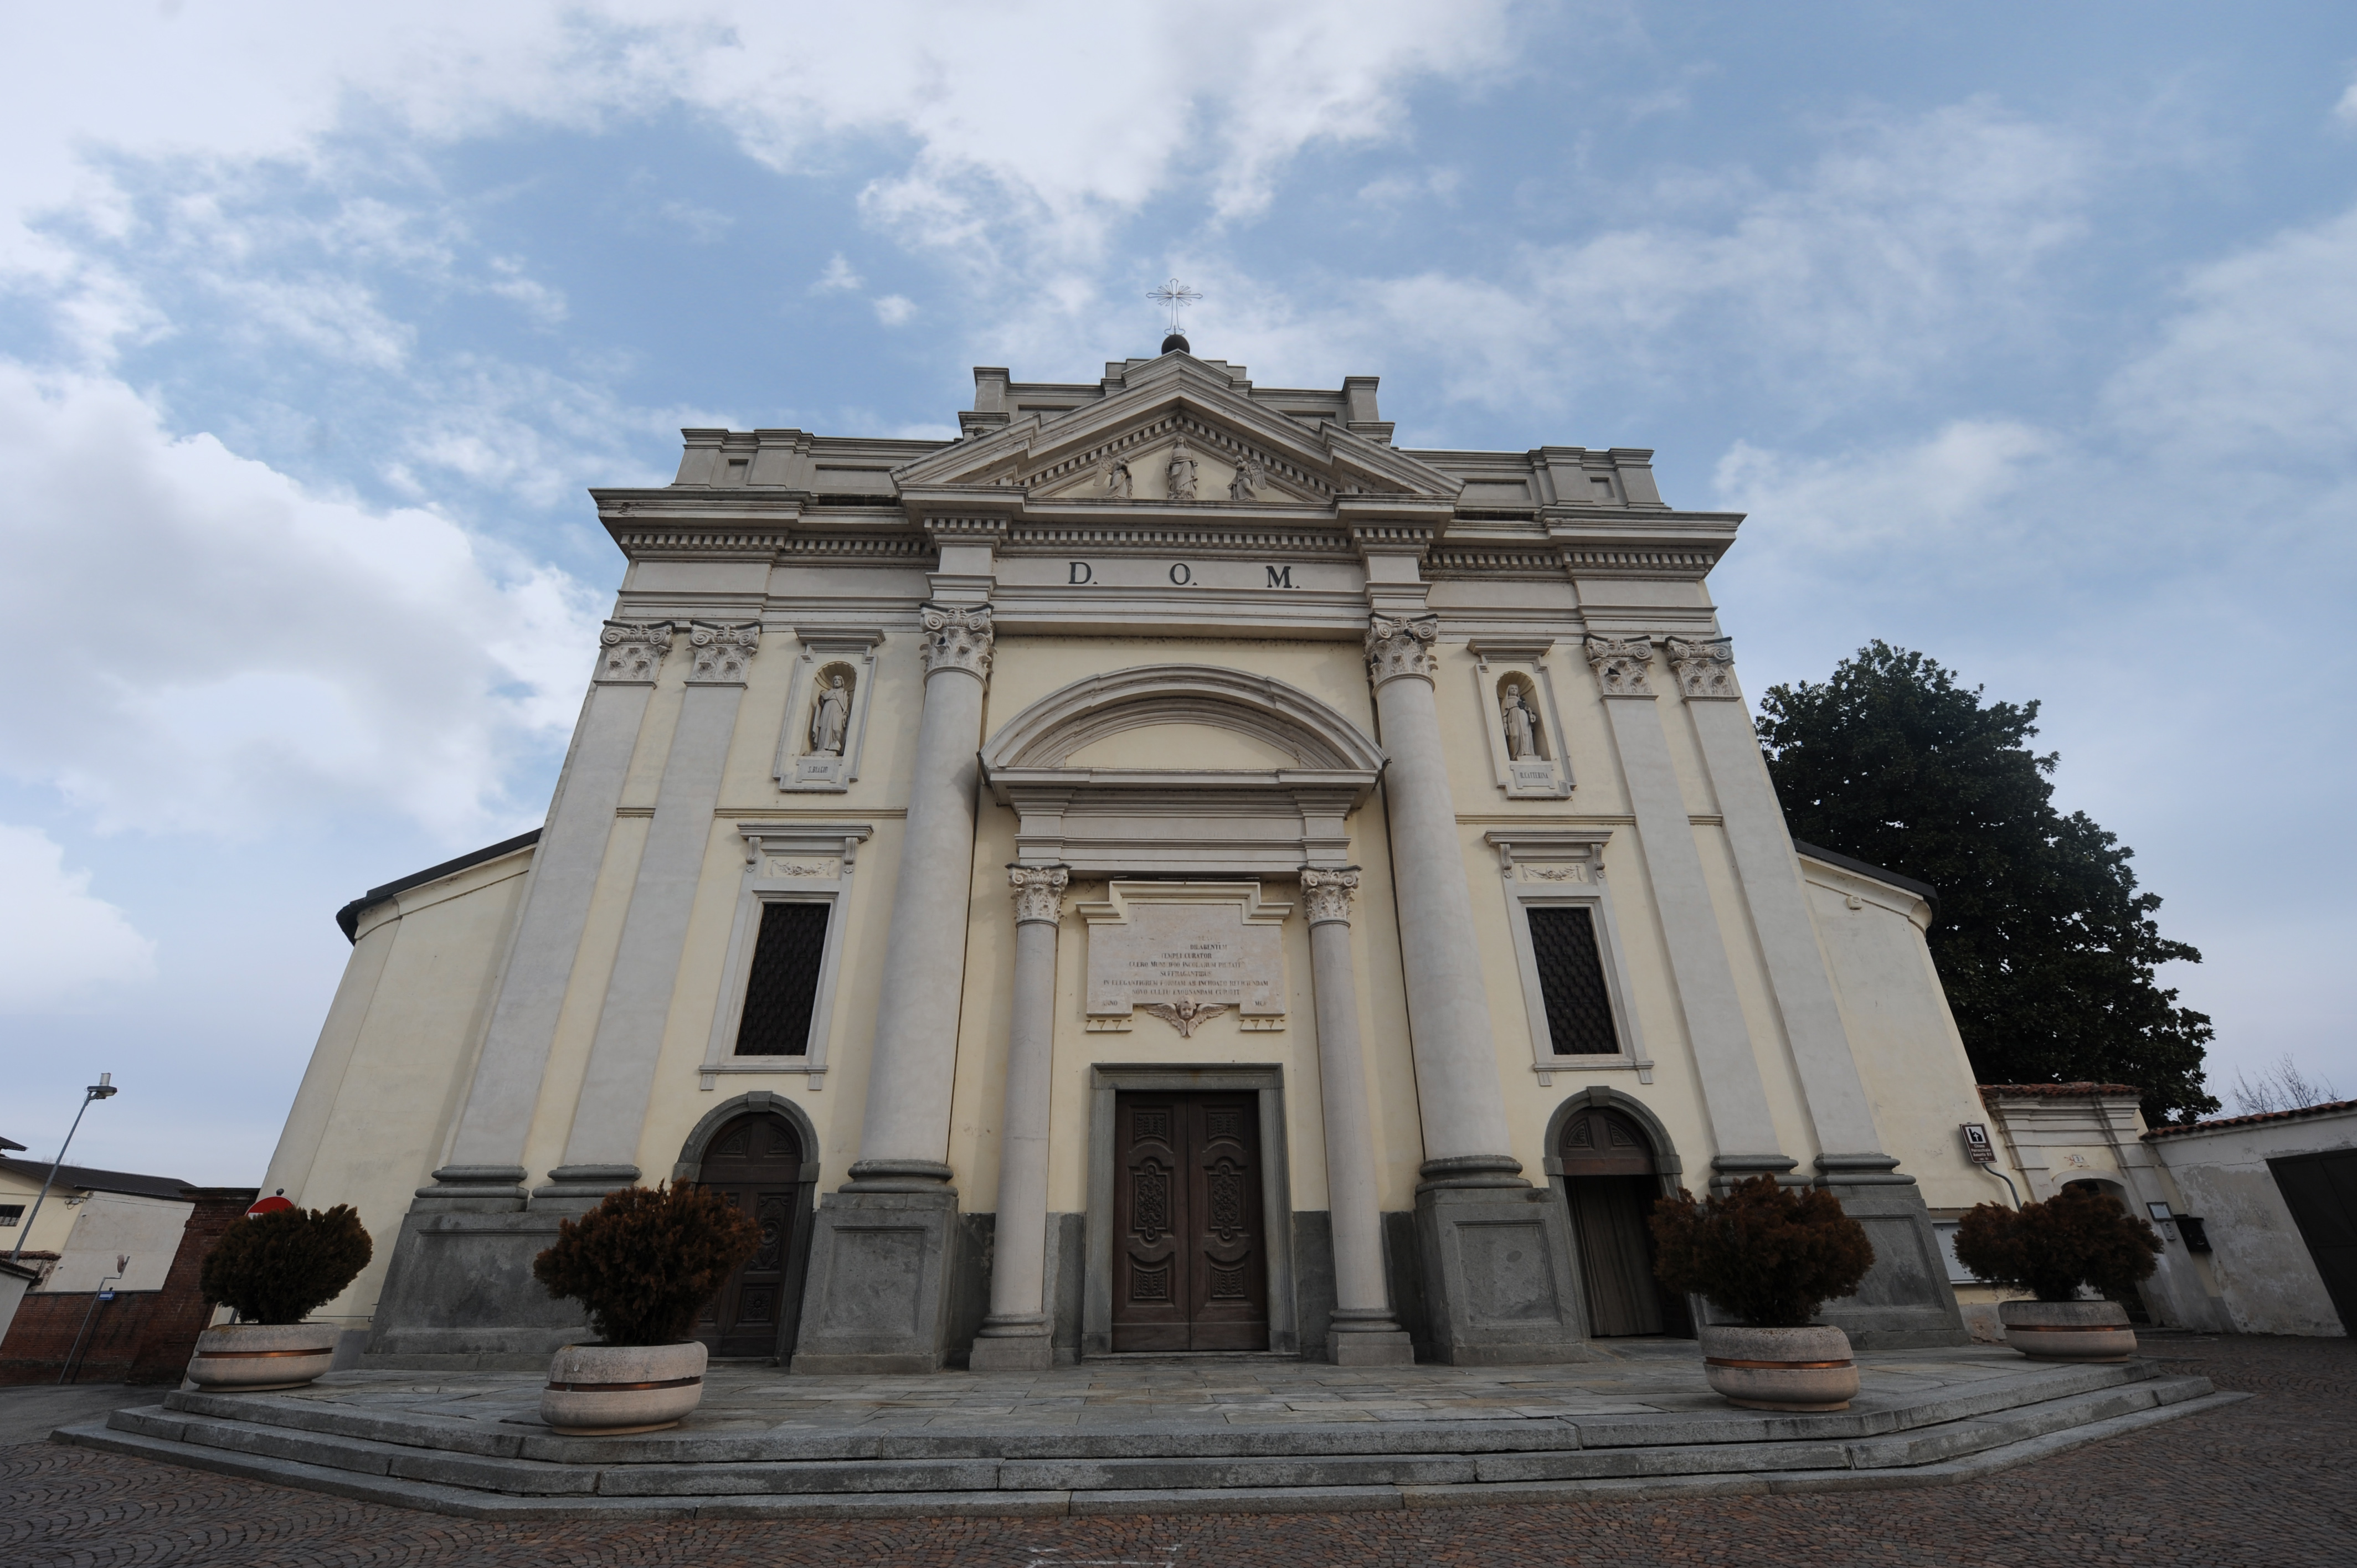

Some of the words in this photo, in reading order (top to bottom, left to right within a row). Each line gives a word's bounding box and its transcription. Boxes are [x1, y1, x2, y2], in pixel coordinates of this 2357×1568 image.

[1068, 561, 1098, 585] D.
[1169, 563, 1197, 586] O.
[1265, 565, 1300, 589] M.
